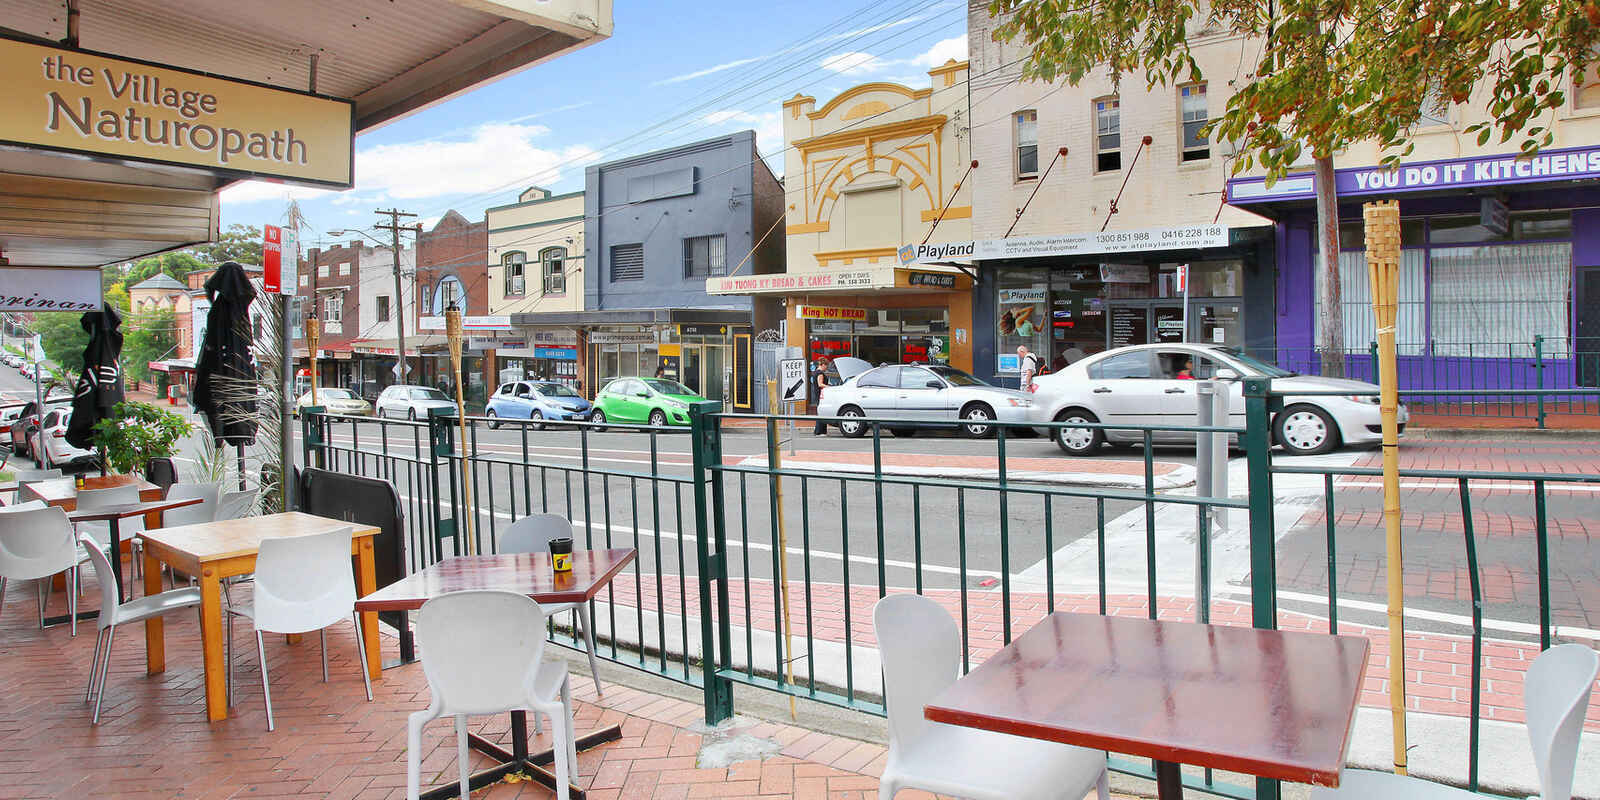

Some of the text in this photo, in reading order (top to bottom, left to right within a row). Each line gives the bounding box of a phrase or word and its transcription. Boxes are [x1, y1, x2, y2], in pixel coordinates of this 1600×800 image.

[42, 55, 218, 118] the Village
[47, 91, 309, 164] Naturopath
[1355, 151, 1600, 190] YOU DO IT KITCHENS
[1096, 235, 1116, 243] 1300
[1117, 234, 1131, 242] 851
[1161, 230, 1184, 239] 0416
[1185, 229, 1202, 237] 228
[1205, 228, 1221, 236] 188
[917, 241, 976, 260] Playland
[772, 277, 795, 288] BREAD
[797, 276, 804, 287] &
[808, 275, 832, 287] CAKES
[802, 306, 820, 318] King
[823, 307, 838, 318] HOT
[785, 362, 802, 370] KEEP
[786, 370, 802, 378] LEFT
